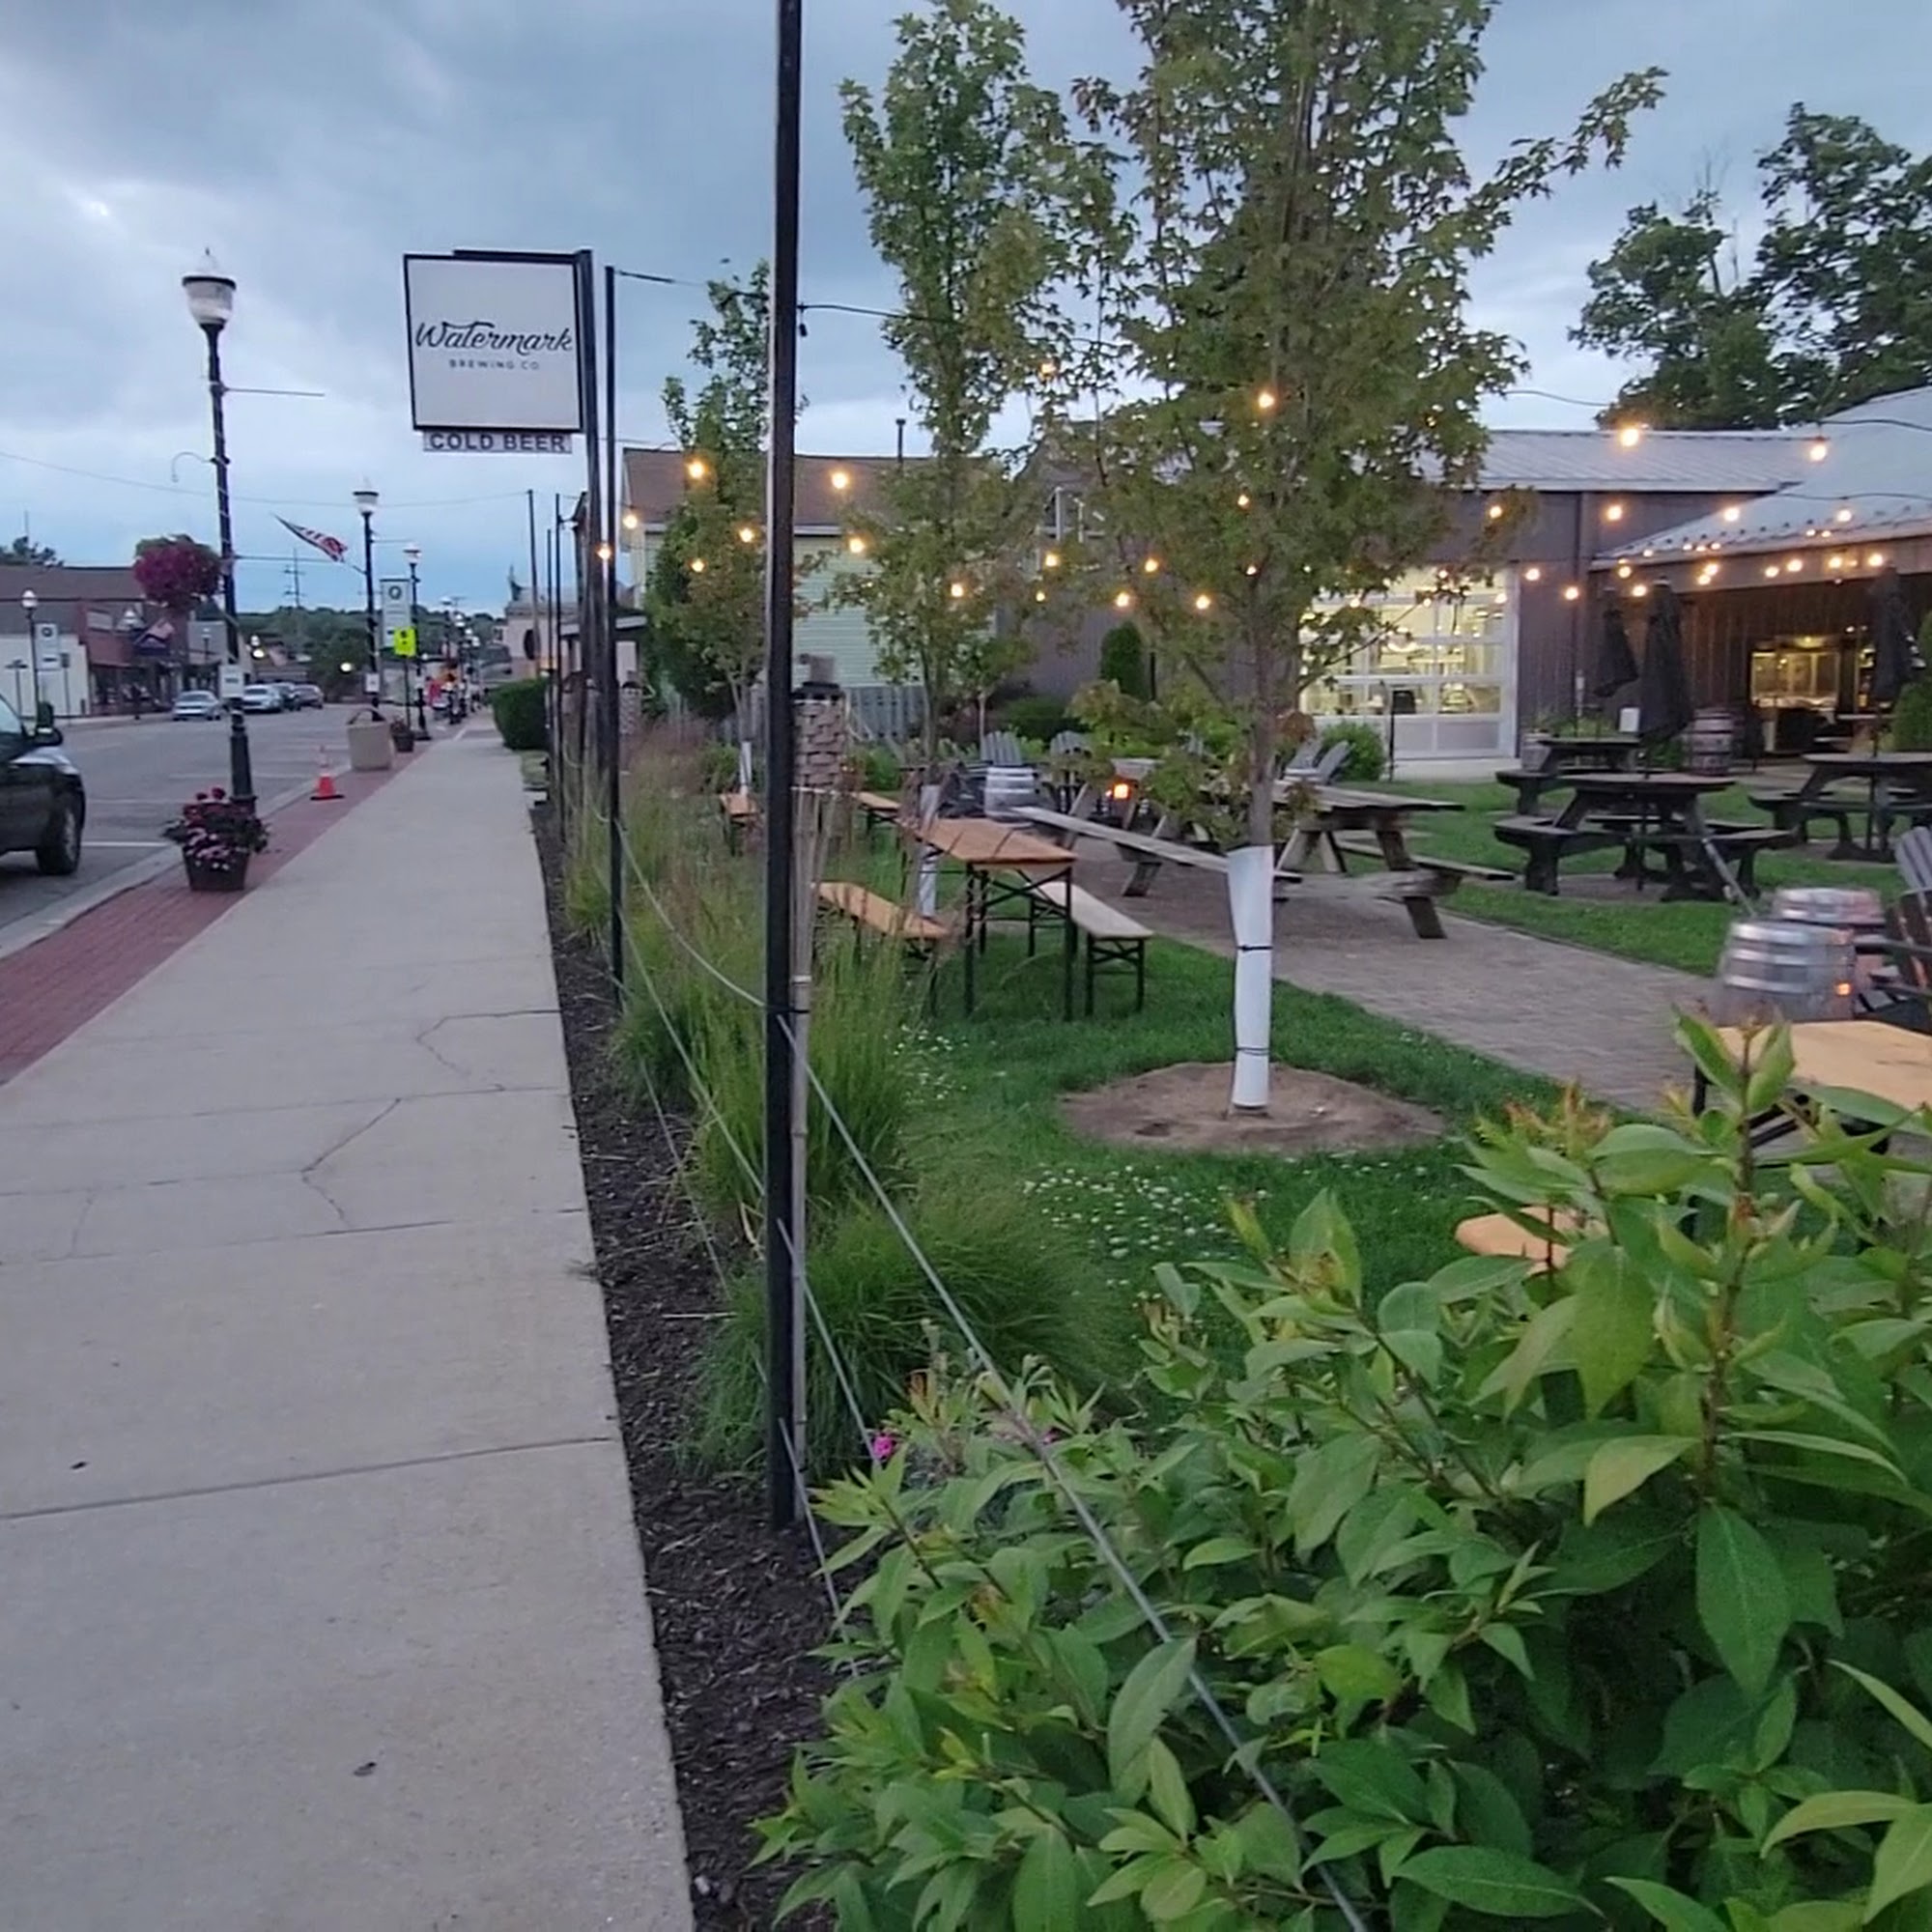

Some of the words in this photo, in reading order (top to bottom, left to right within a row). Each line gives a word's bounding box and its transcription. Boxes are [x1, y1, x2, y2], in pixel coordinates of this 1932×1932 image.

[415, 321, 573, 355] Watermark
[449, 358, 515, 370] BREWING
[430, 433, 495, 450] COLD
[503, 434, 565, 452] BEER
